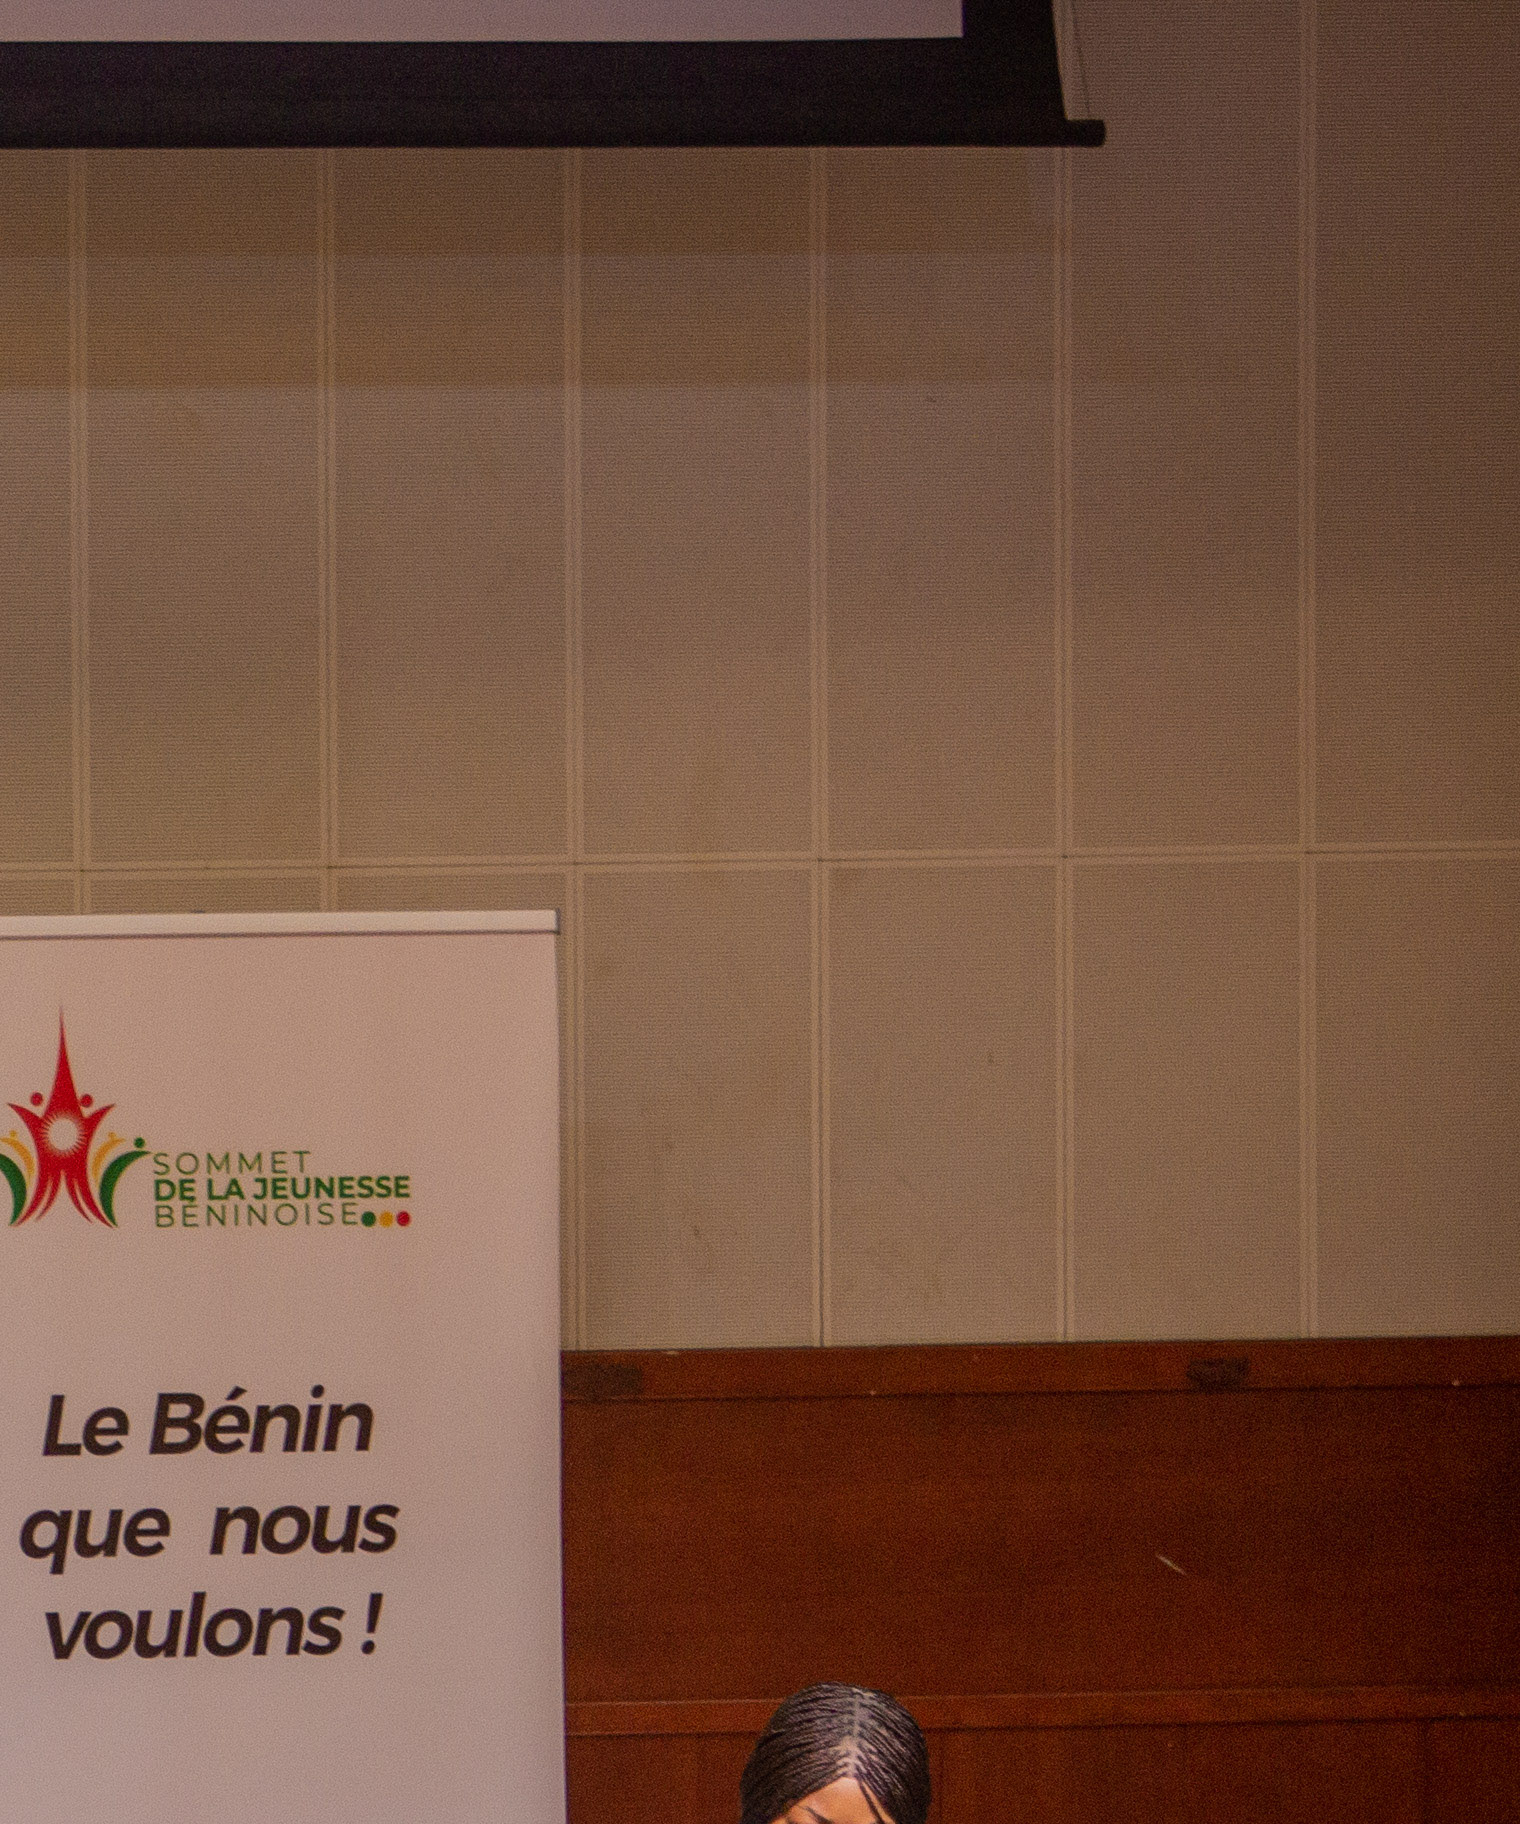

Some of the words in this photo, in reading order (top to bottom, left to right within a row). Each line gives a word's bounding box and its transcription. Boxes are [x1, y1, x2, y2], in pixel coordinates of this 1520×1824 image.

[153, 1150, 311, 1175] SOMMET
[154, 1178, 196, 1202] DE
[208, 1178, 245, 1201] LA
[253, 1175, 410, 1199] JEUNESSE
[42, 1393, 130, 1457] Le
[148, 1384, 375, 1456] Bénin
[18, 1505, 172, 1575] que
[209, 1503, 401, 1556] nous
[44, 1590, 346, 1660] voulons
